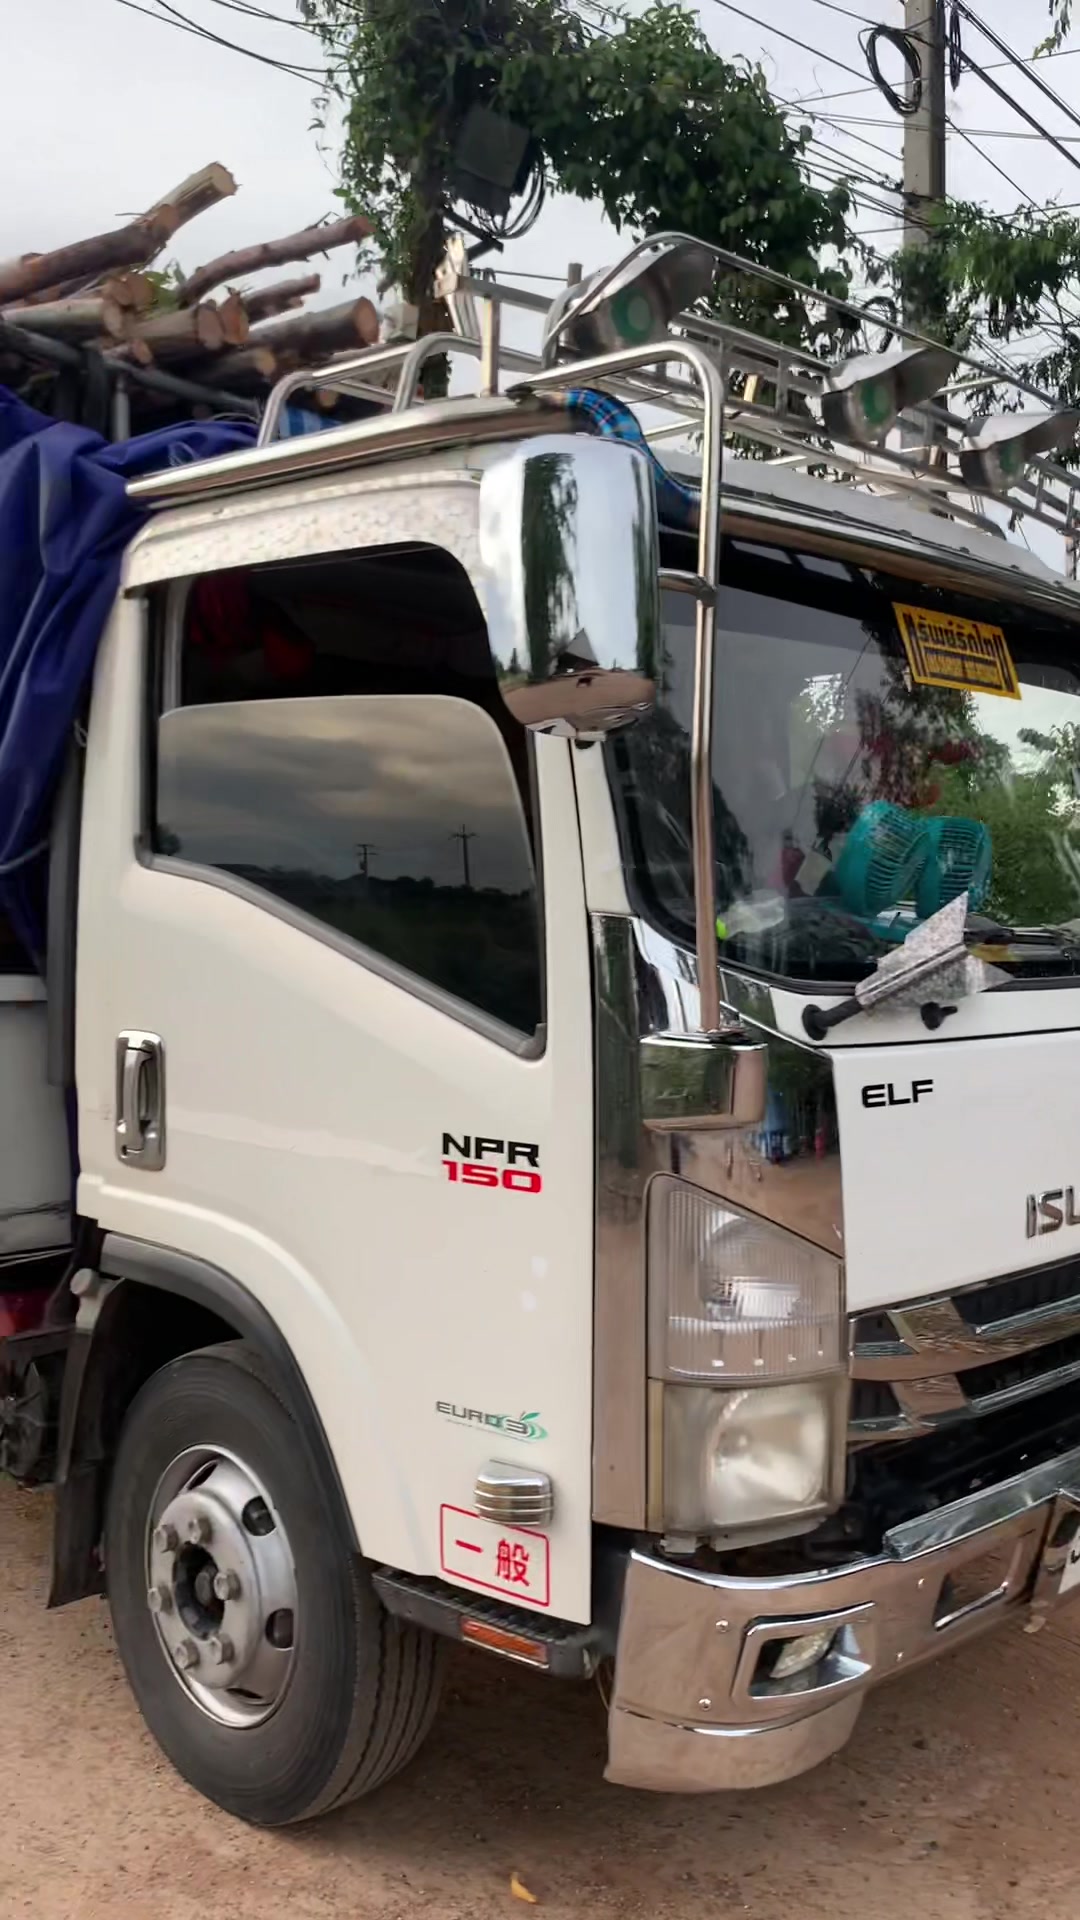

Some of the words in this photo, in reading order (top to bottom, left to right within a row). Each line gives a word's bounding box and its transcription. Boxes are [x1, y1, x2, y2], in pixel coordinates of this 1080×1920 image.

[861, 1079, 933, 1108] ELF
[442, 1132, 539, 1168] NPR
[442, 1160, 542, 1194] 150
[455, 1537, 529, 1586] 一般
